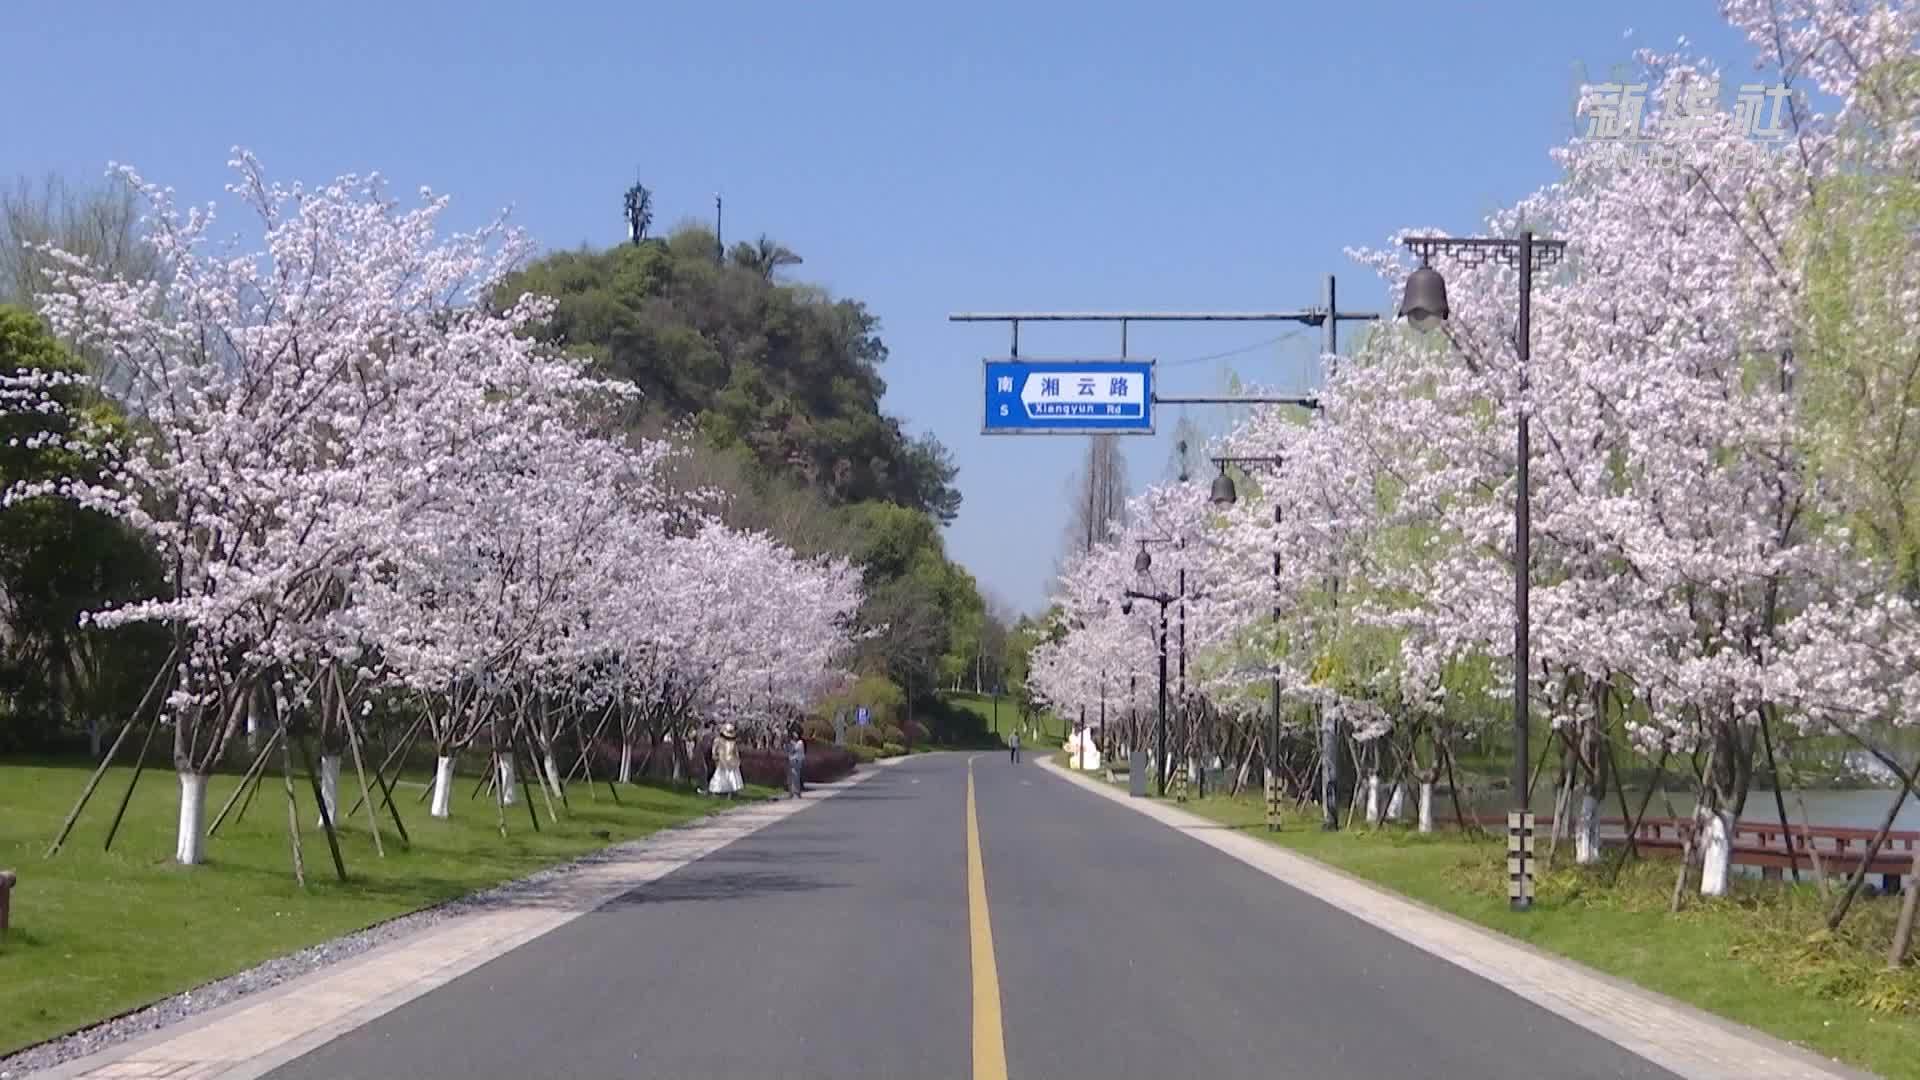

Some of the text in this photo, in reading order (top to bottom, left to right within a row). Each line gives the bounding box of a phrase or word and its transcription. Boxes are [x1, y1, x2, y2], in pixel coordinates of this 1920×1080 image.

[997, 375, 1014, 393] 南
[1041, 376, 1128, 397] 湘云路
[999, 404, 1009, 416] S
[1035, 403, 1121, 416] Xiangyun Rd
